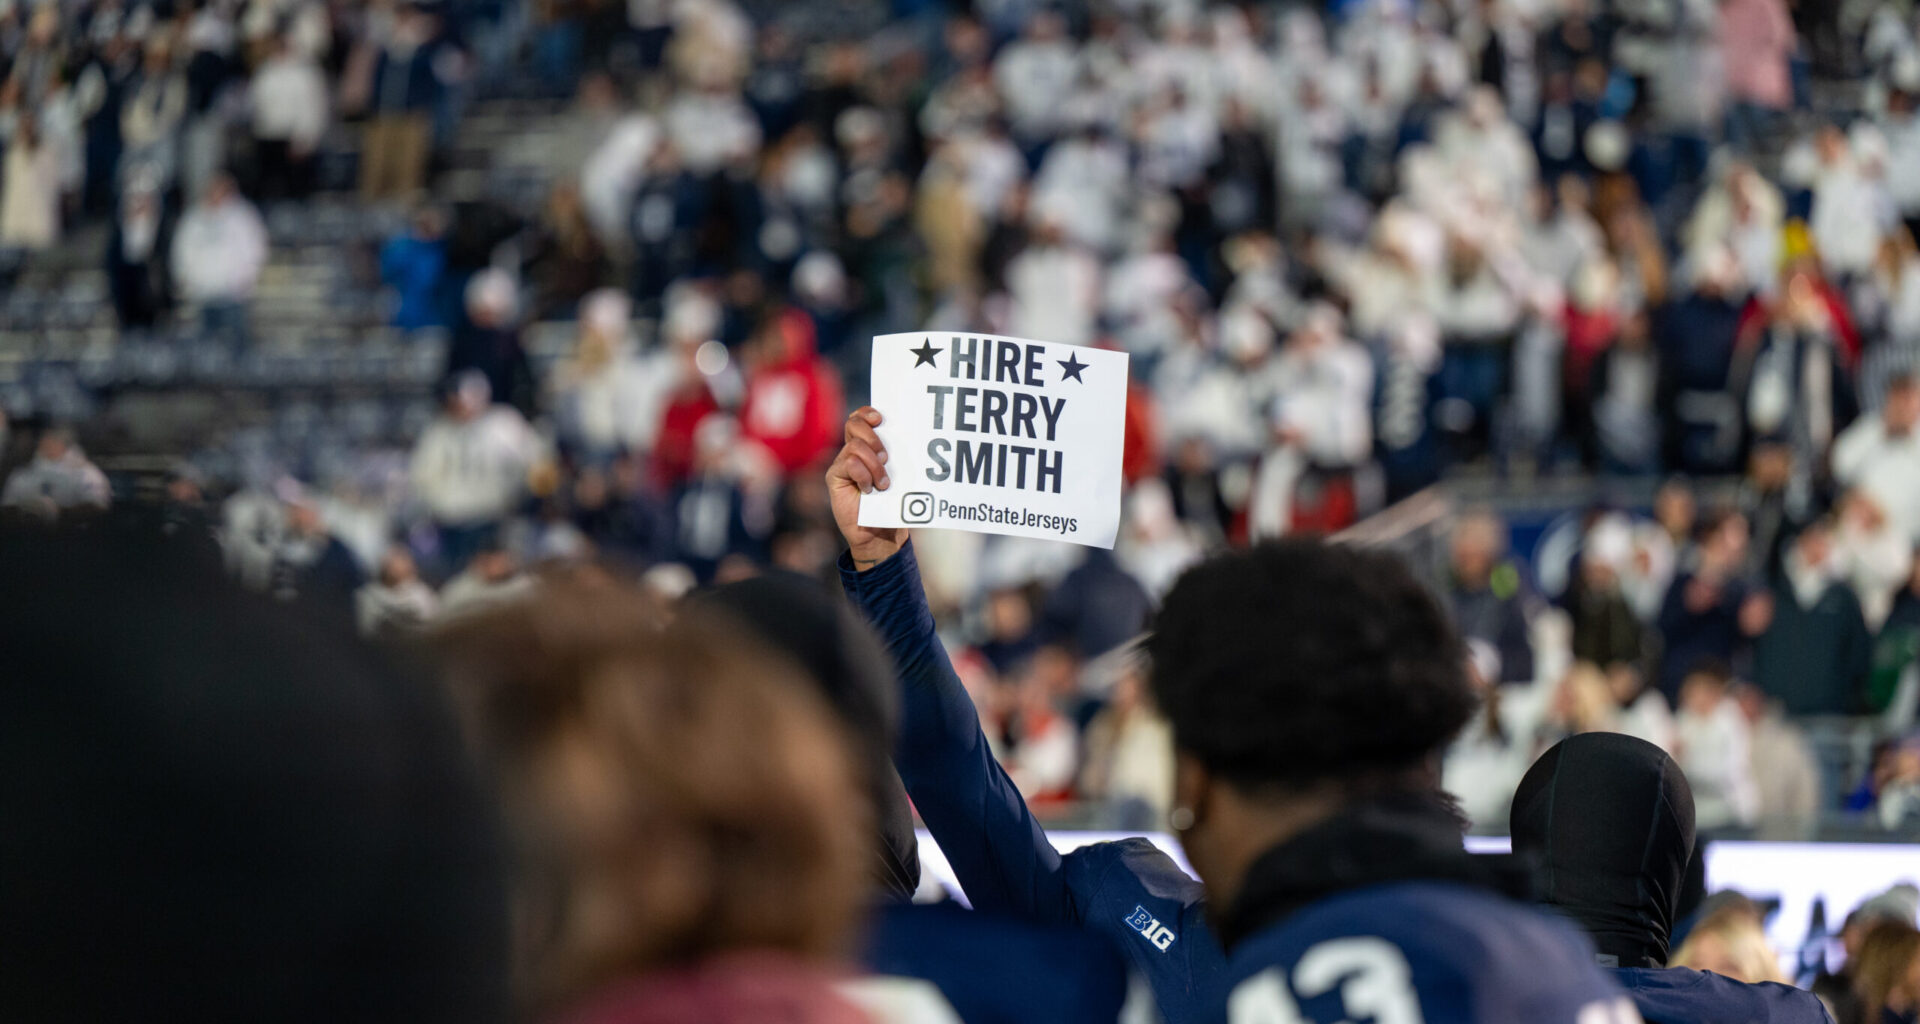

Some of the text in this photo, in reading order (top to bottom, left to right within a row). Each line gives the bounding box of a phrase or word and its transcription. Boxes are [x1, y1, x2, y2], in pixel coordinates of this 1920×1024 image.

[950, 337, 1045, 386] HIRE
[927, 385, 1066, 441] TERRY
[925, 437, 1063, 494] SMITH
[939, 499, 1077, 534] PennStateJerseys
